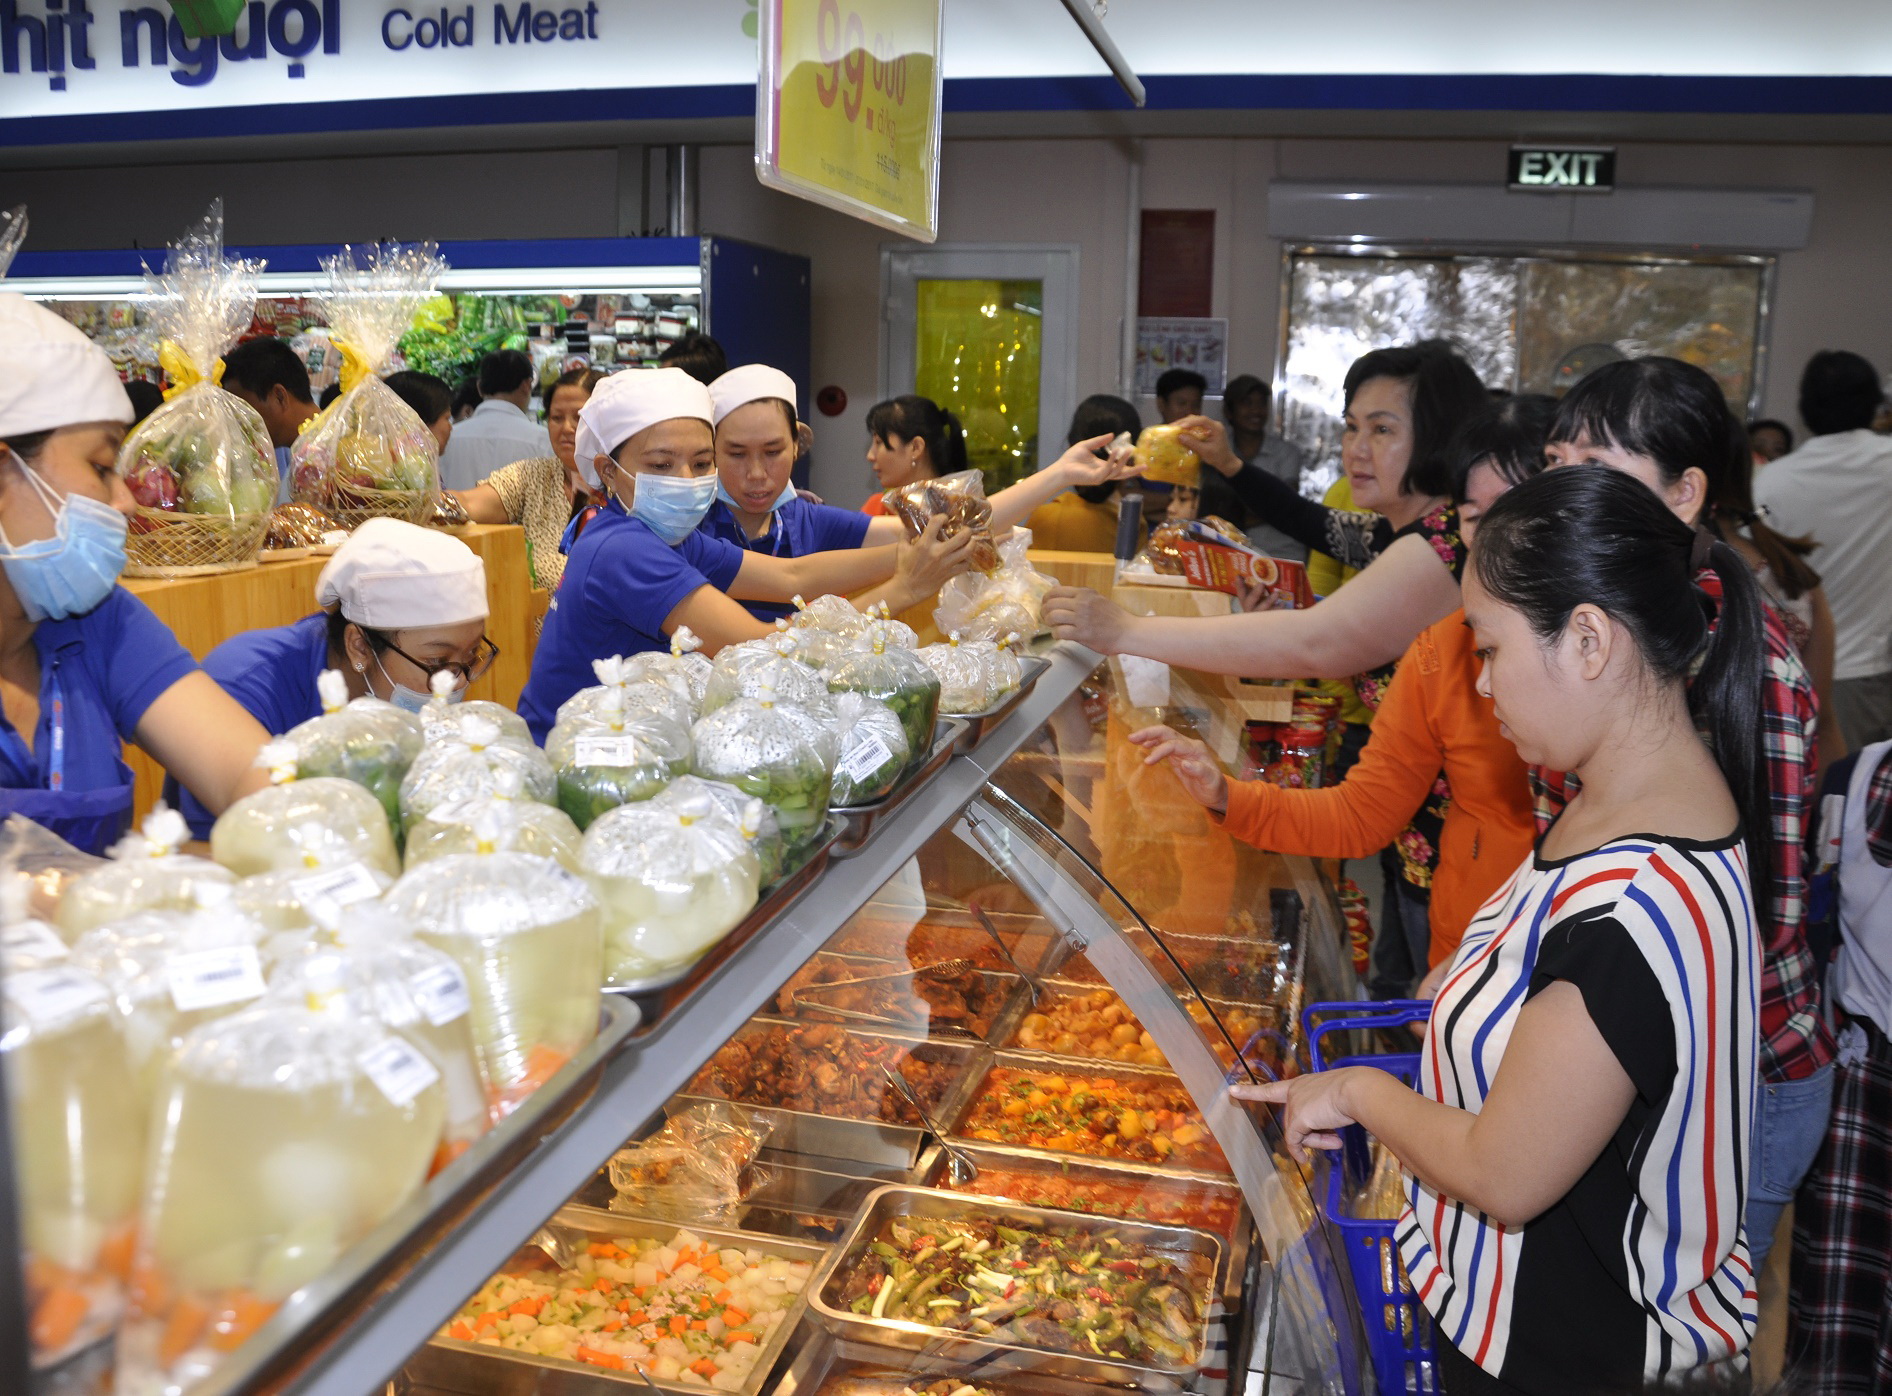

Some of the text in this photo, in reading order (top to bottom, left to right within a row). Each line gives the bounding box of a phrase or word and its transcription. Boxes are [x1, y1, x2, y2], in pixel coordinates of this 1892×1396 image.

[381, 1, 599, 51] Cold Meat
[1519, 152, 1604, 186] EXIT
